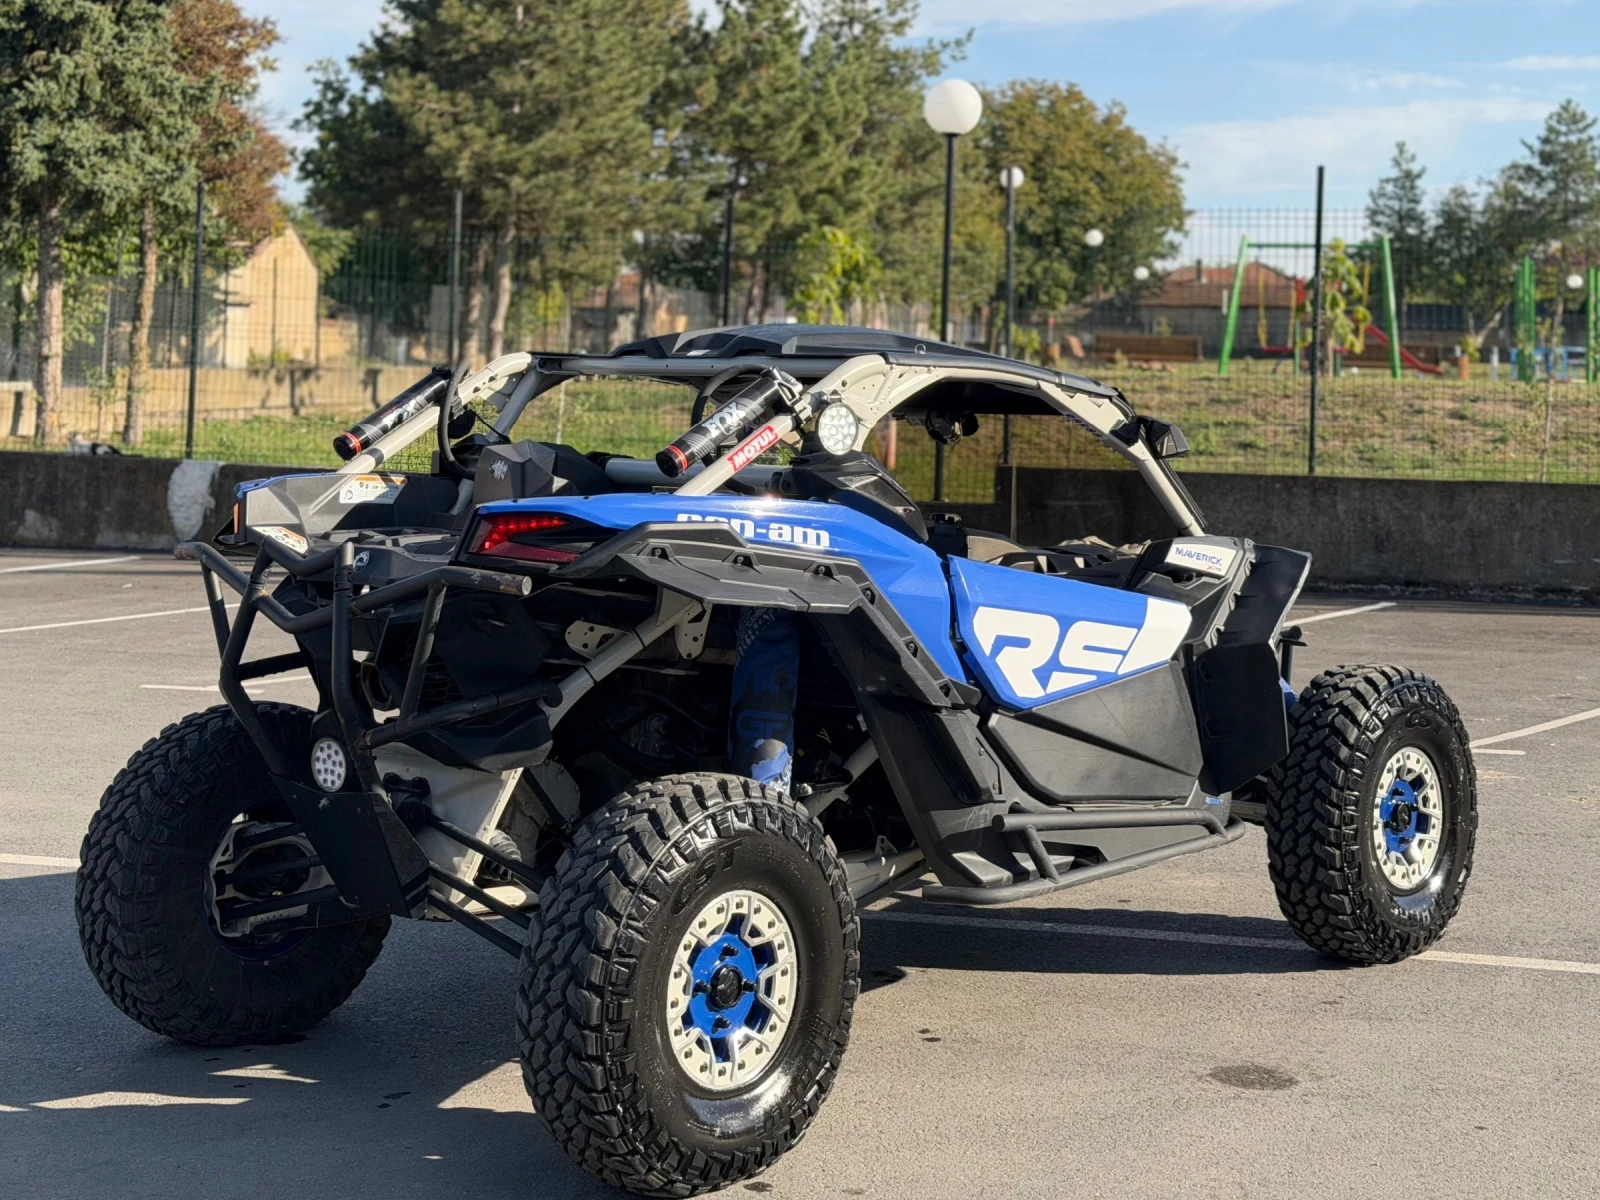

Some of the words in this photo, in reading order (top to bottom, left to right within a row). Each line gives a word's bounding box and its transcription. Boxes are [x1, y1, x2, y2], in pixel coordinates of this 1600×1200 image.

[702, 402, 747, 438] FOX
[733, 429, 778, 468] MOTUL
[1175, 547, 1222, 566] MAVERICK
[973, 606, 1138, 698] RS
[671, 838, 743, 915] CST
